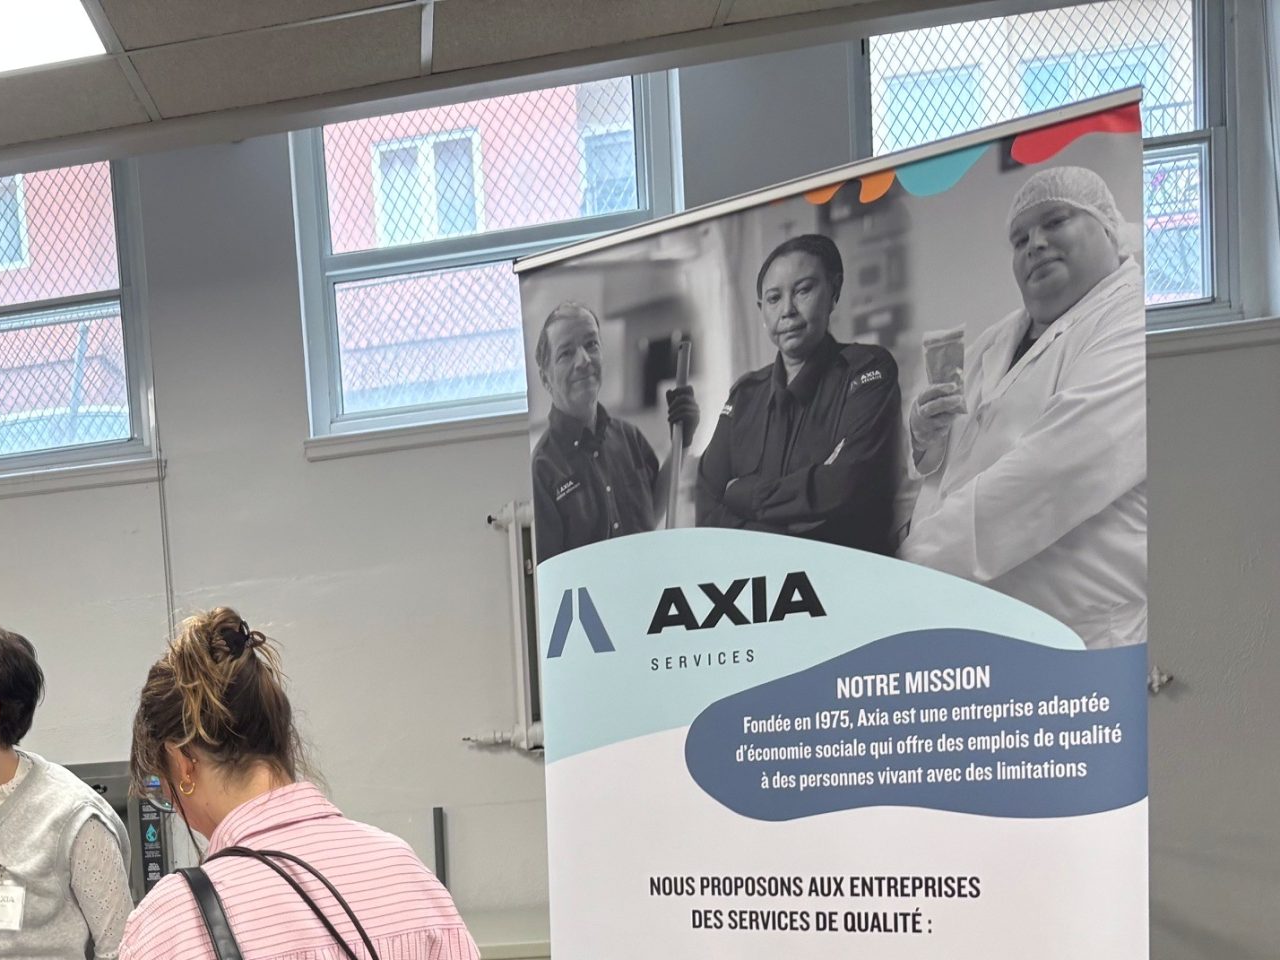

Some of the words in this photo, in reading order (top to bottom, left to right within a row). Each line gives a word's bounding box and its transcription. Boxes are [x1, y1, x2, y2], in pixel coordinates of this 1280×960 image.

[647, 571, 827, 635] AXIA
[651, 649, 754, 671] SERVICES
[837, 673, 900, 698] NOTRE
[906, 666, 990, 693] MISSION
[744, 714, 791, 733] Fondée
[795, 717, 811, 730] en
[816, 710, 854, 731] 1975,
[857, 709, 889, 726] Axia
[893, 708, 916, 724] est
[920, 708, 947, 722] une
[952, 699, 1033, 722] entreprise
[1038, 692, 1109, 717] adaptée
[816, 739, 866, 758] sociale
[870, 738, 892, 759] qui
[897, 735, 933, 754] offre
[937, 734, 963, 752] des
[968, 730, 1029, 753] emplois
[1034, 728, 1054, 747] de
[1059, 723, 1121, 749] qualité
[761, 772, 769, 788] à
[773, 771, 796, 788] des
[800, 772, 874, 791] personnes
[878, 767, 923, 784] vivant
[927, 768, 961, 782] avec
[966, 763, 992, 781] des
[997, 760, 1087, 779] limitations
[650, 877, 695, 896] NOUS
[700, 877, 803, 897] PROPOSONS
[808, 877, 844, 897] AUX
[850, 877, 980, 898] ENTREPRISES
[692, 910, 723, 929] DES
[728, 910, 810, 931] SERVICES
[816, 912, 838, 931] DE
[844, 908, 922, 933] QUALITÉ
